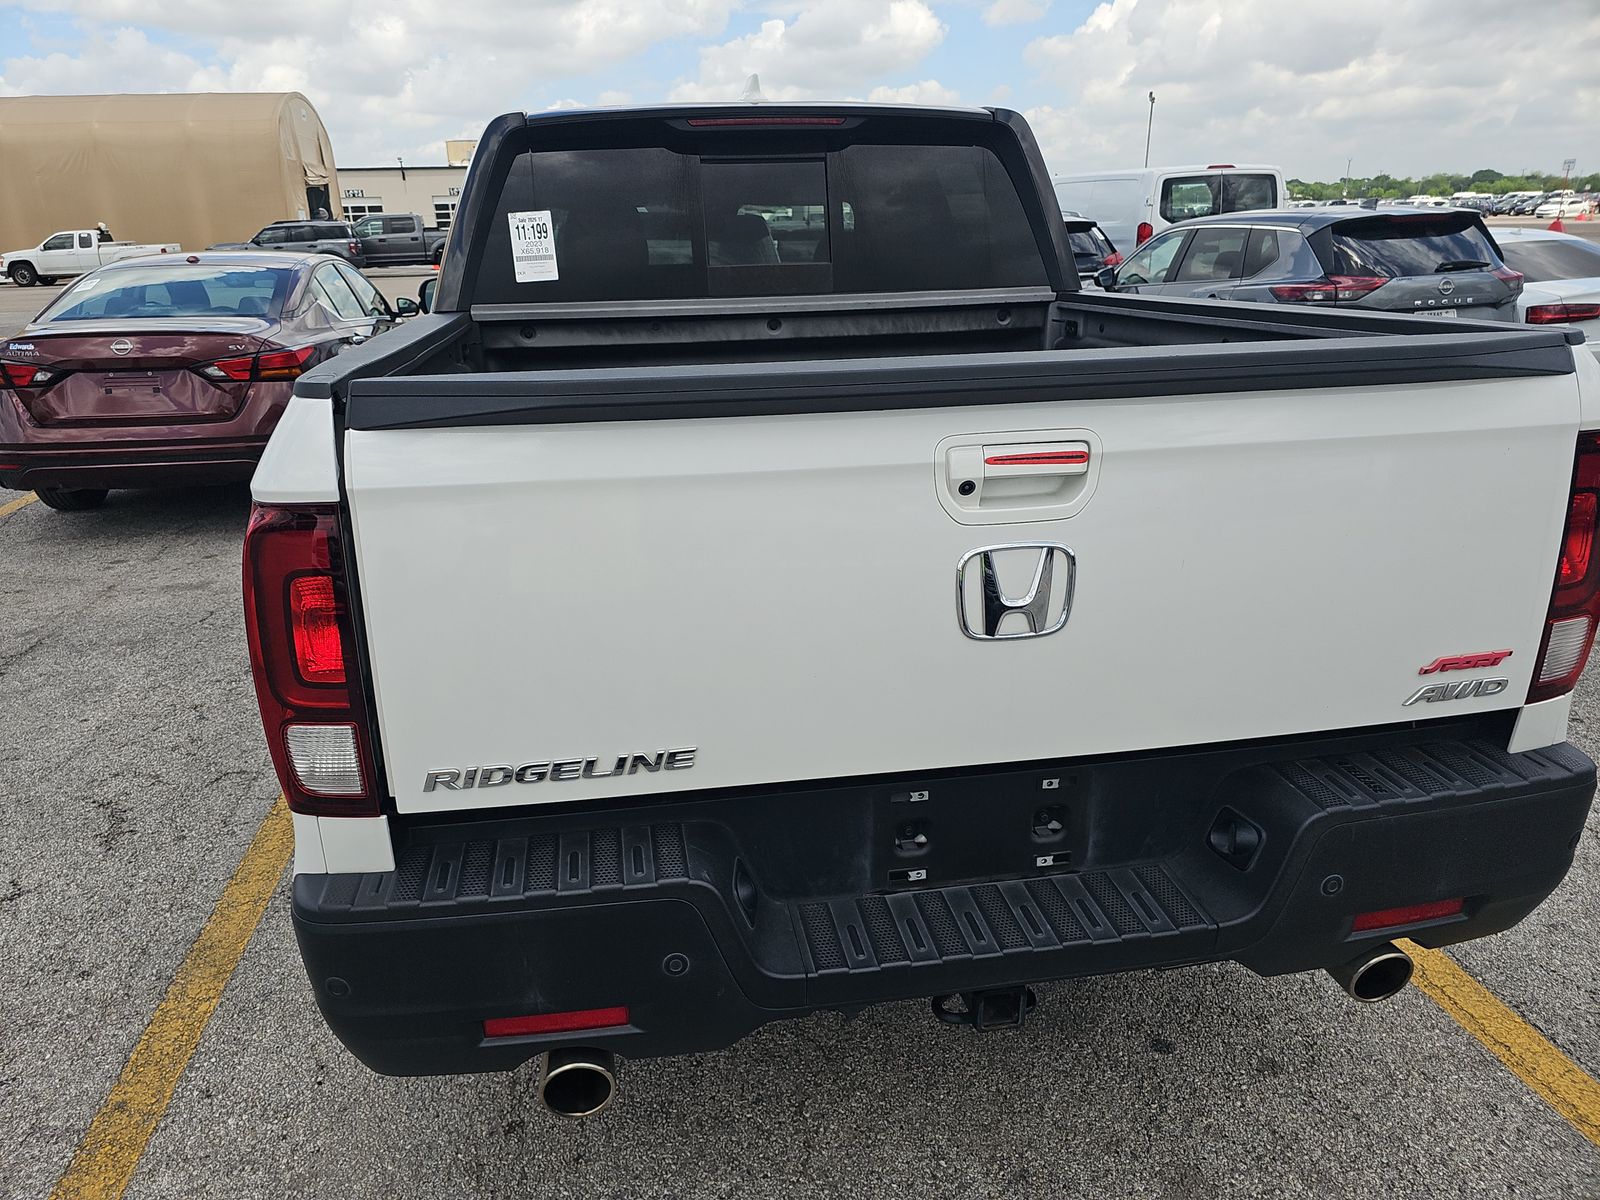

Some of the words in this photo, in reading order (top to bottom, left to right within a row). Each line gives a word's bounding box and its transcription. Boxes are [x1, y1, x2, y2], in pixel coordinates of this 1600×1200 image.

[515, 223, 548, 240] 11:199
[1414, 297, 1473, 306] ROGUE
[1418, 649, 1514, 675] SPORT
[1401, 676, 1509, 706] AWD
[422, 746, 698, 793] RIDGELINE
